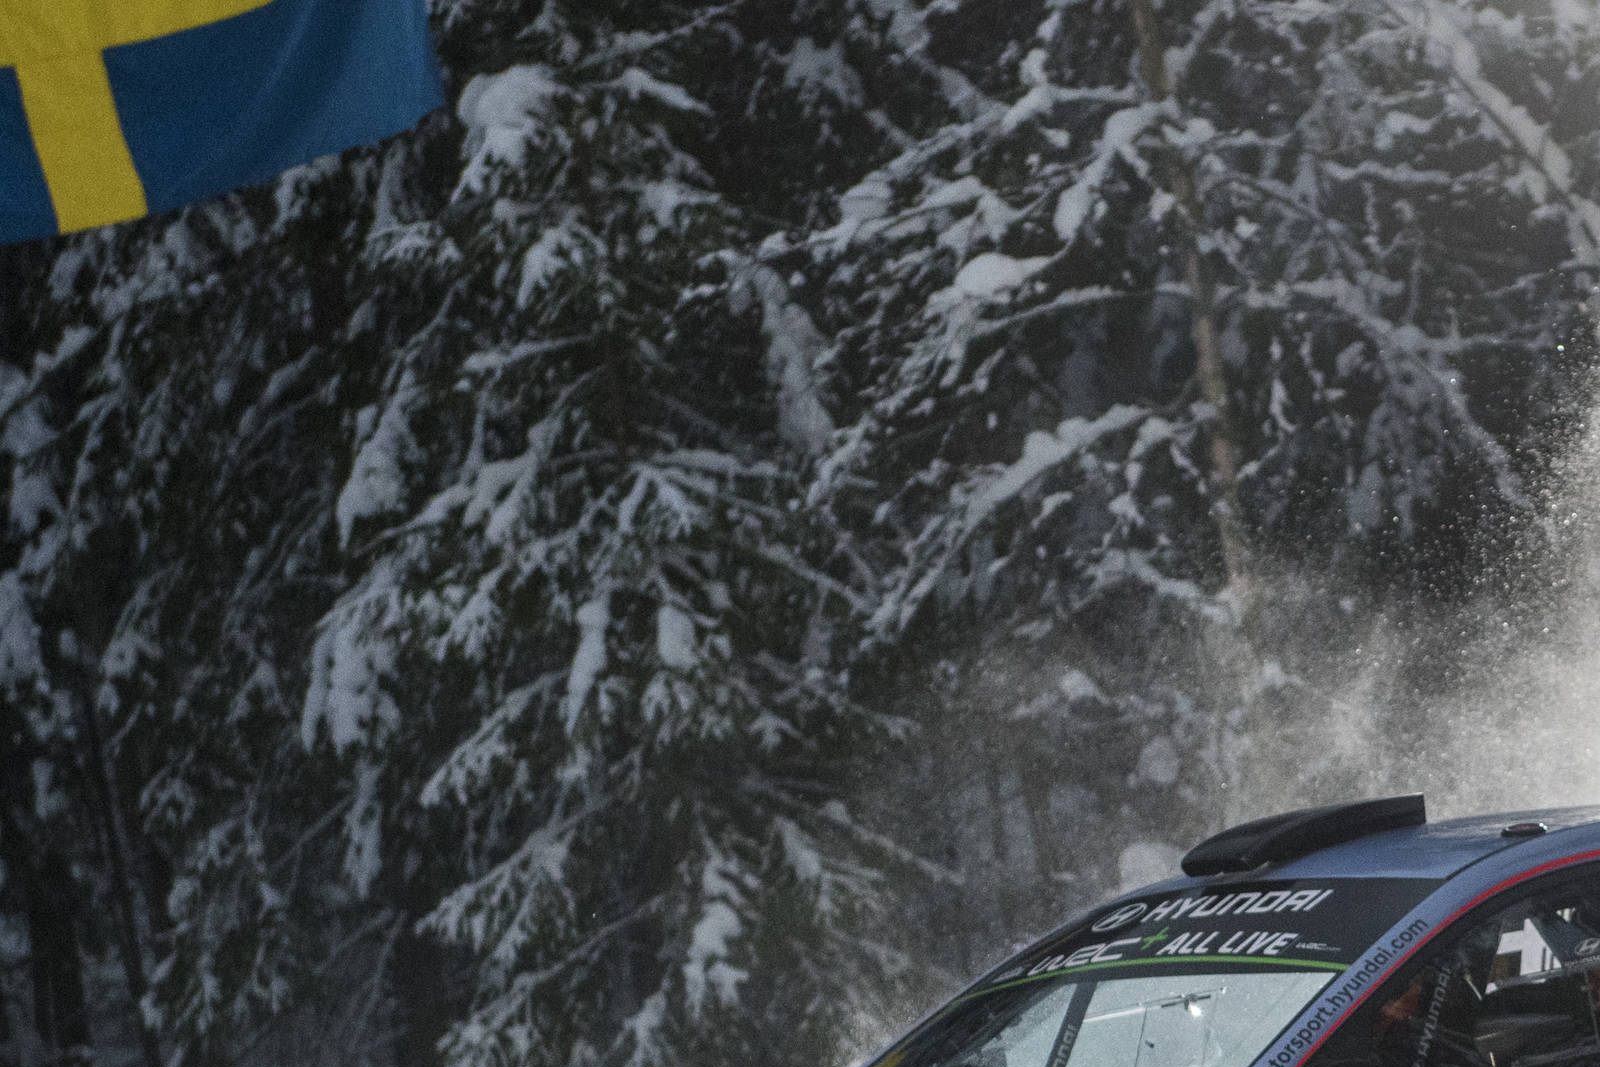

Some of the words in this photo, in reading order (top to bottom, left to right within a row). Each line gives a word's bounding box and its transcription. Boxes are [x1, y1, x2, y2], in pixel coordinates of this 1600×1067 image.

[1141, 889, 1333, 923] HYUNDAI
[1157, 931, 1219, 956] ALL
[1218, 931, 1298, 956] LIVE
